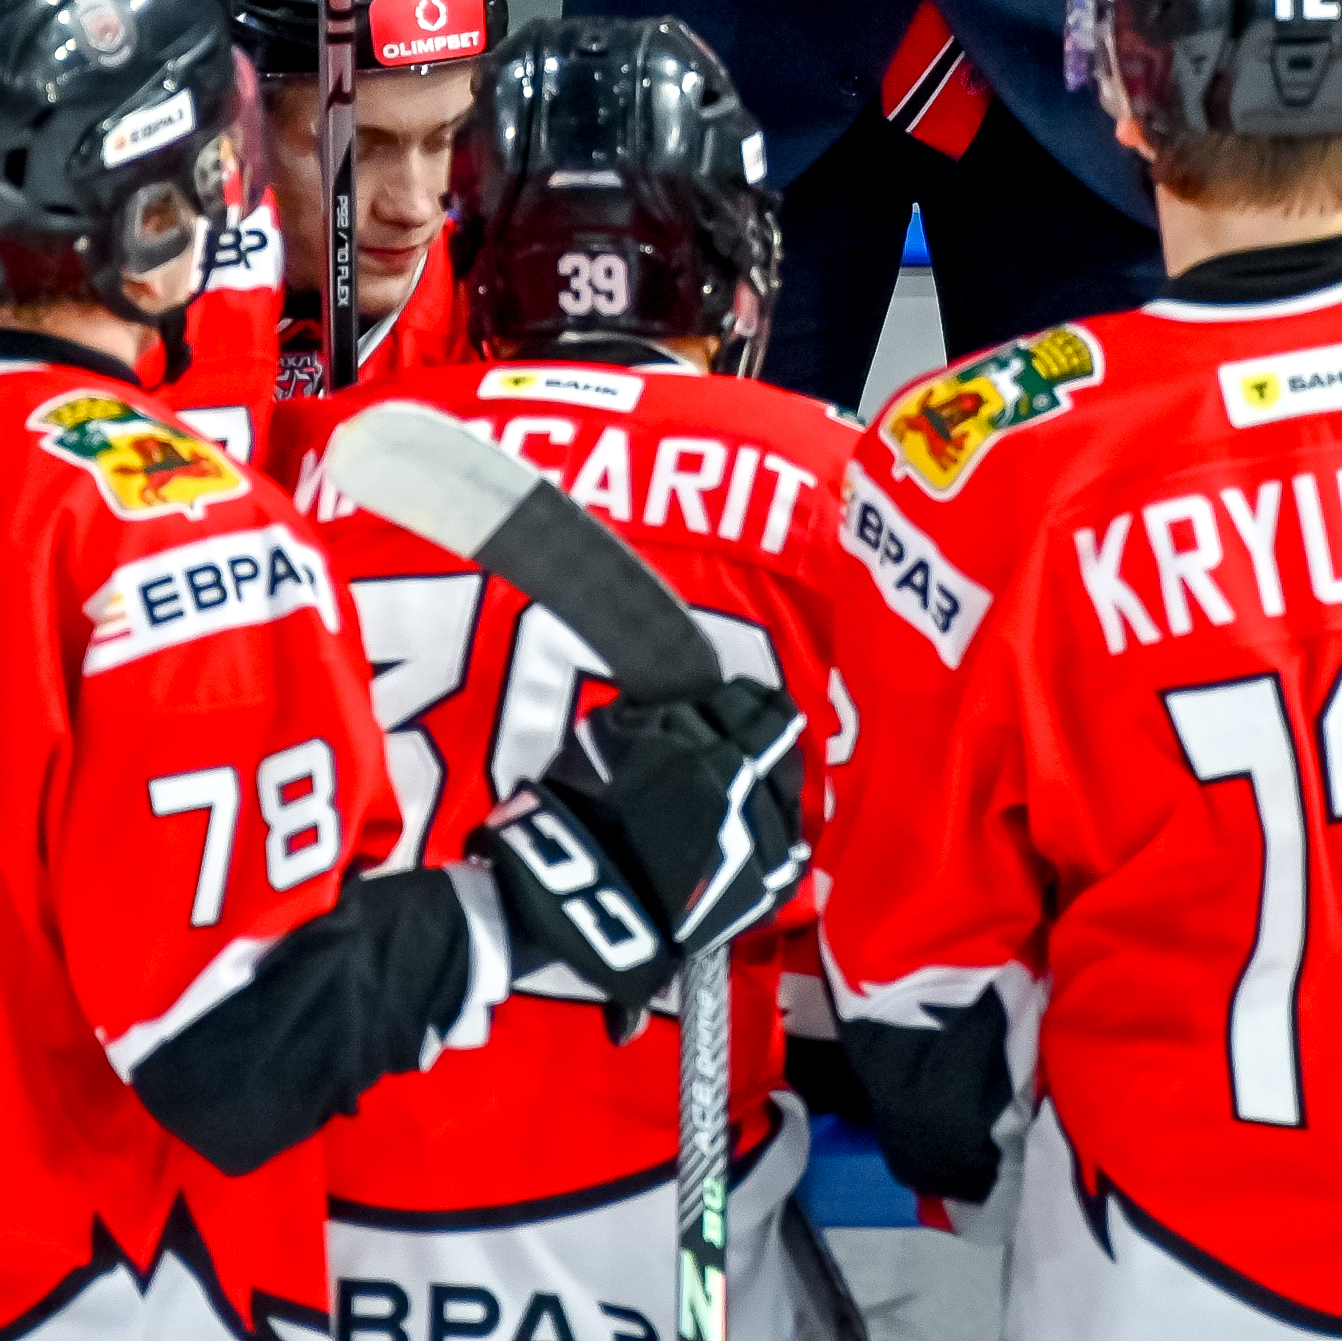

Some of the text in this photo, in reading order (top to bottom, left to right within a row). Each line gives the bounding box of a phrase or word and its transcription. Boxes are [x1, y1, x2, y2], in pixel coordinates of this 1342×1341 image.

[382, 30, 481, 59] OLIMPBET
[337, 265, 349, 308] FLEX
[558, 252, 629, 317] 39
[853, 501, 962, 635] ВРАЗ
[147, 737, 344, 929] 78
